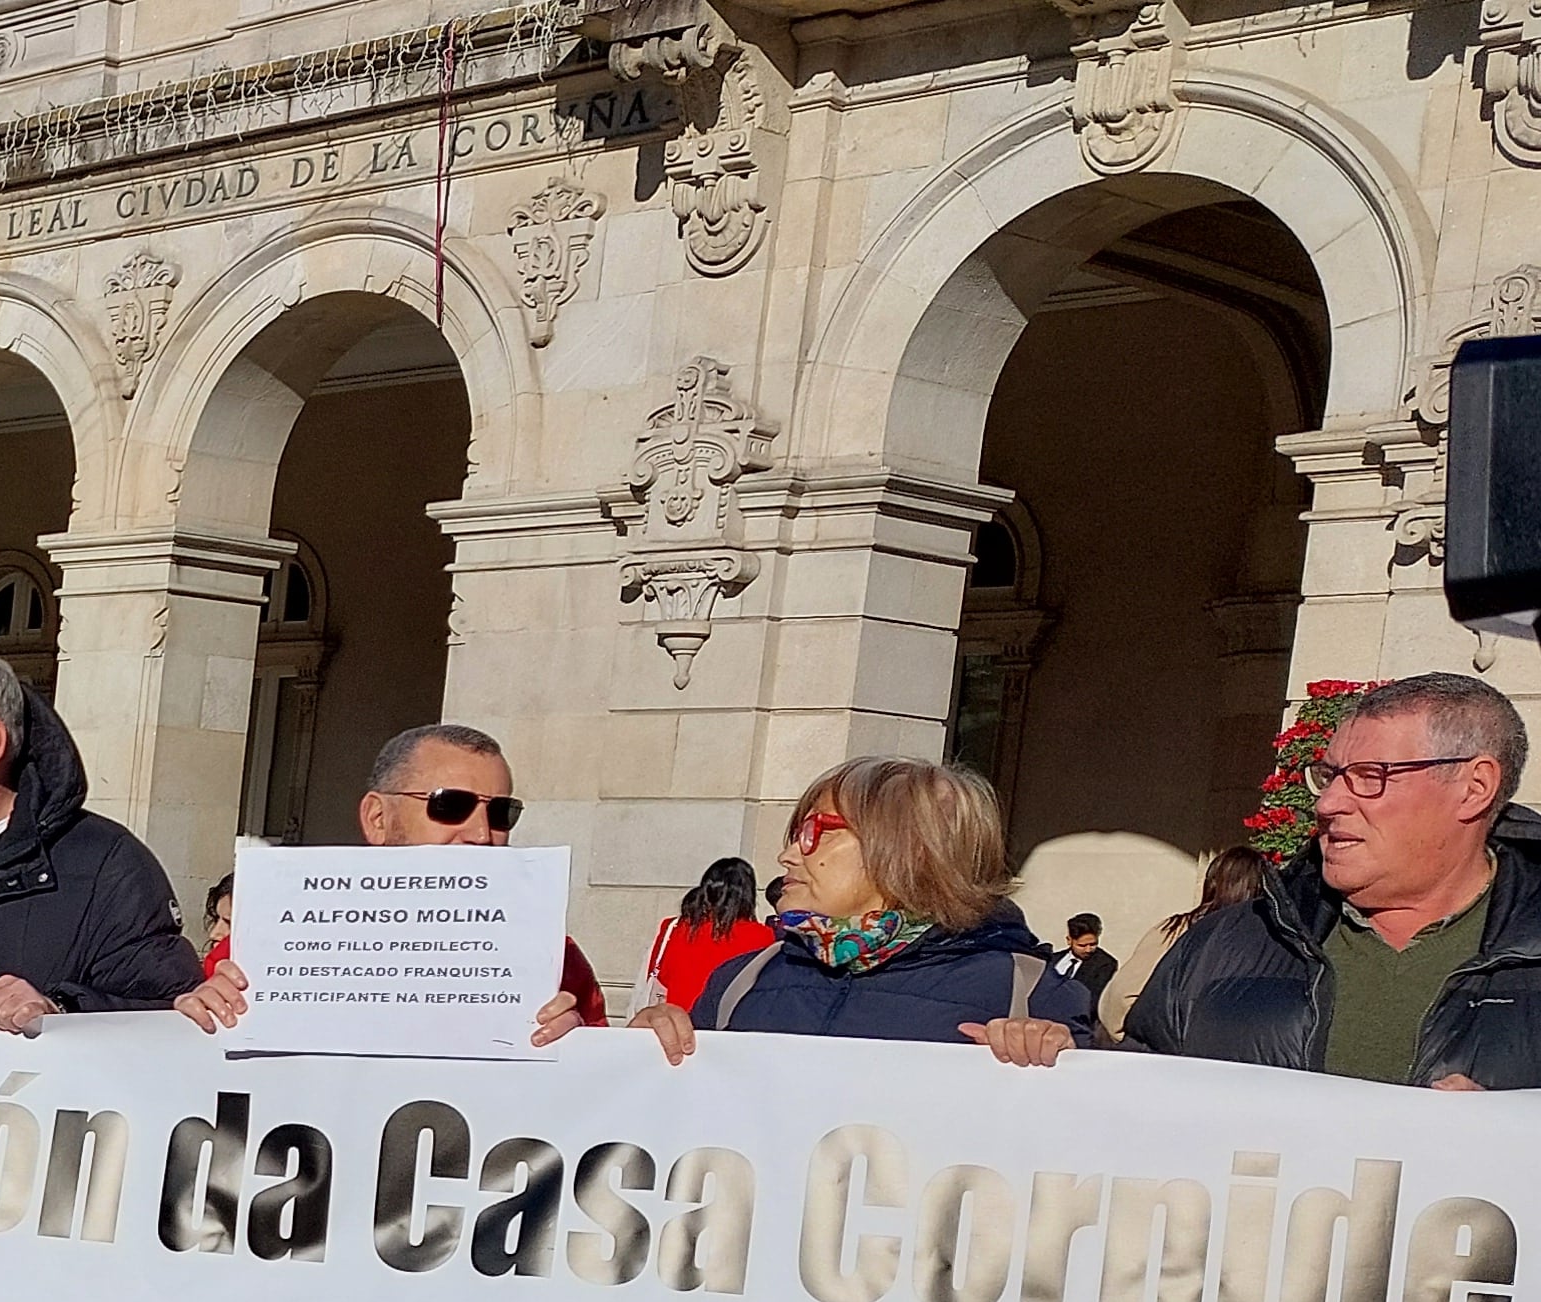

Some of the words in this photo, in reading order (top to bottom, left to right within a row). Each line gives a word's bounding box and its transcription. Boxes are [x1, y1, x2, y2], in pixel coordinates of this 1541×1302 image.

[6, 199, 89, 241] LEAL
[115, 165, 260, 220] CIVDAD
[289, 150, 340, 189] DE
[369, 136, 419, 175] LA
[302, 876, 353, 891] NON
[360, 874, 490, 892] QUEREMOS
[279, 909, 296, 924] A
[301, 908, 409, 924] ALFONSO
[416, 908, 507, 924] MOLINA
[283, 940, 332, 952] COMO
[336, 940, 384, 952] FILLO
[388, 939, 500, 952] PREDILECTO.
[266, 965, 294, 977] FOI
[298, 965, 399, 978] DESTACADO
[403, 965, 514, 979] FRANQUISTA
[254, 991, 265, 1002] E
[269, 990, 391, 1004] PARTICIPANTE
[396, 991, 419, 1003] NA
[424, 990, 522, 1005] REPRESIÓN
[154, 1091, 335, 1263] da
[371, 1098, 759, 1299] Casa
